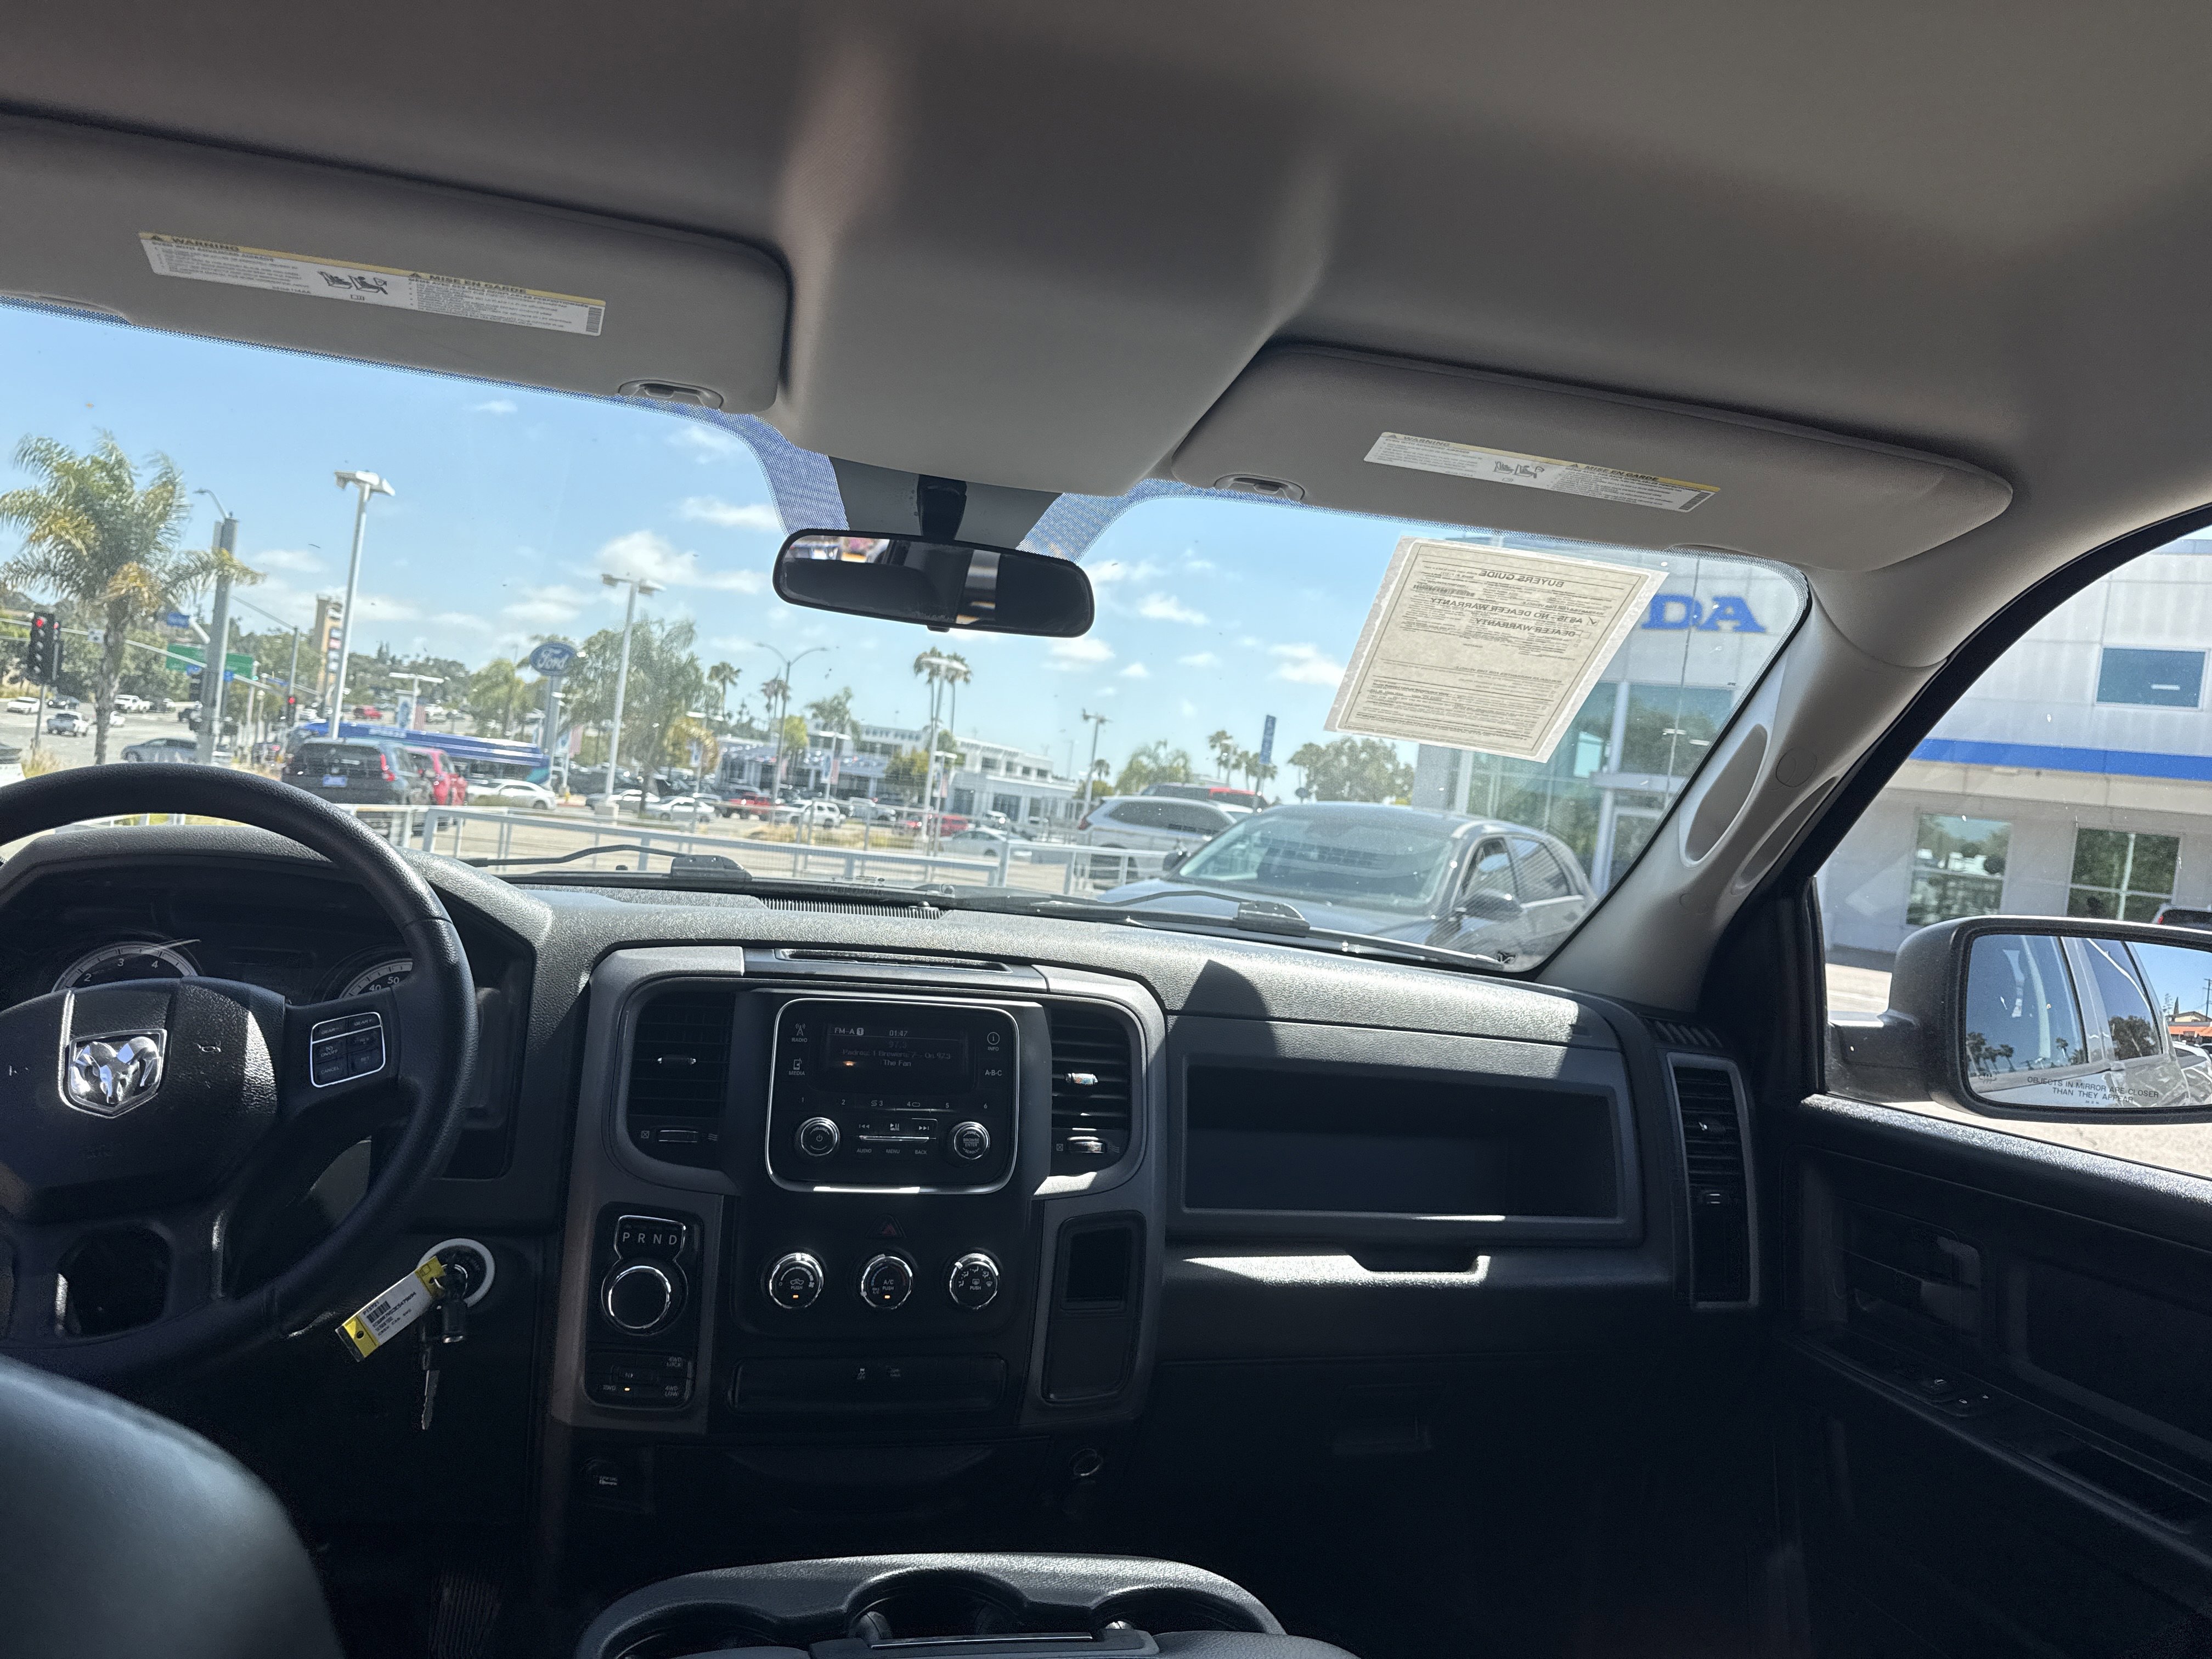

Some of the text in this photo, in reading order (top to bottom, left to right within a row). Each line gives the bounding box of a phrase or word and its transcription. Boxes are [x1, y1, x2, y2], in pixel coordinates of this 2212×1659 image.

[430, 275, 461, 284] MISE
[484, 284, 527, 294] GARDE
[1403, 436, 1451, 447] WARNING
[1626, 472, 1659, 481] GARDE
[538, 647, 569, 669] Ford
[117, 958, 125, 967] 3
[84, 973, 92, 982] 2
[387, 976, 400, 984] 50
[320, 1066, 339, 1074] CANCEL
[2027, 1076, 2063, 1087] OBJECTS
[2075, 1082, 2106, 1092] MIRROR
[2128, 1088, 2159, 1098] CLOSER
[2052, 1087, 2074, 1096] THAN
[2078, 1090, 2098, 1099] THEY
[2102, 1093, 2134, 1103] APPEAR
[622, 1232, 677, 1245] P R N D
